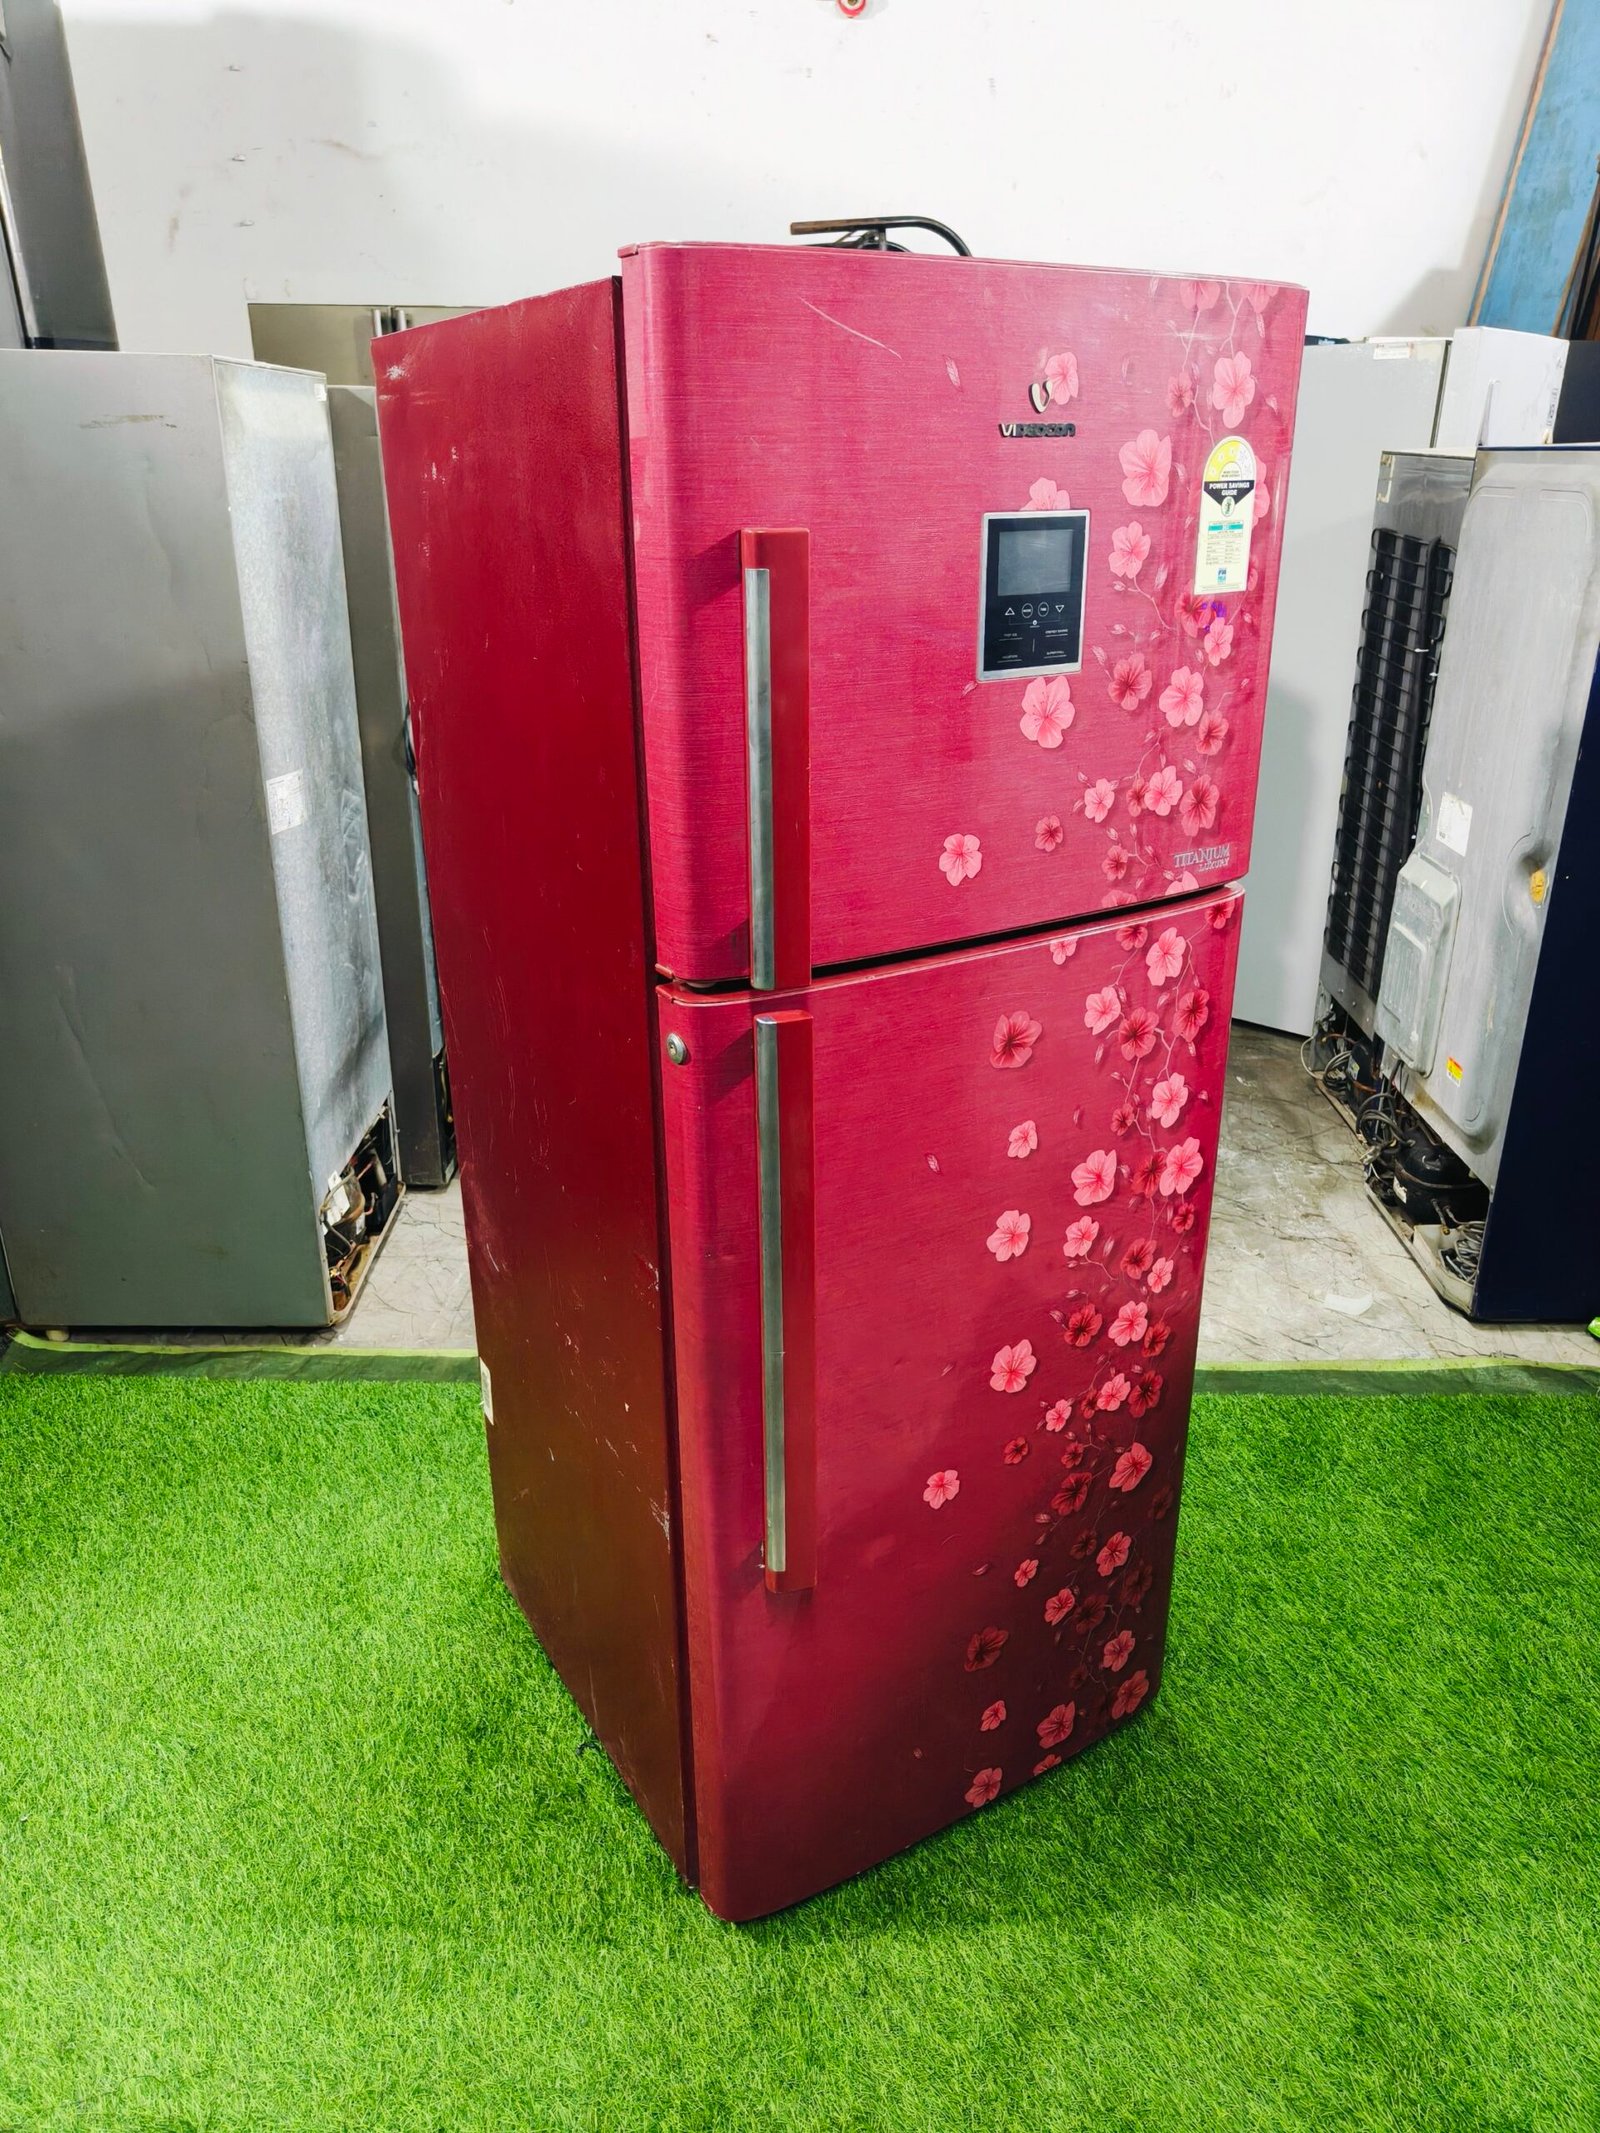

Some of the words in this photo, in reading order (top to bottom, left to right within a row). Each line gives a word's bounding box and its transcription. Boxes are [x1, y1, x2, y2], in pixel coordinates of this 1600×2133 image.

[1209, 482, 1228, 490] POWER
[1228, 481, 1250, 489] SAVINGS
[1174, 843, 1231, 868] TITANIUM
[1198, 857, 1230, 872] LUXURY
